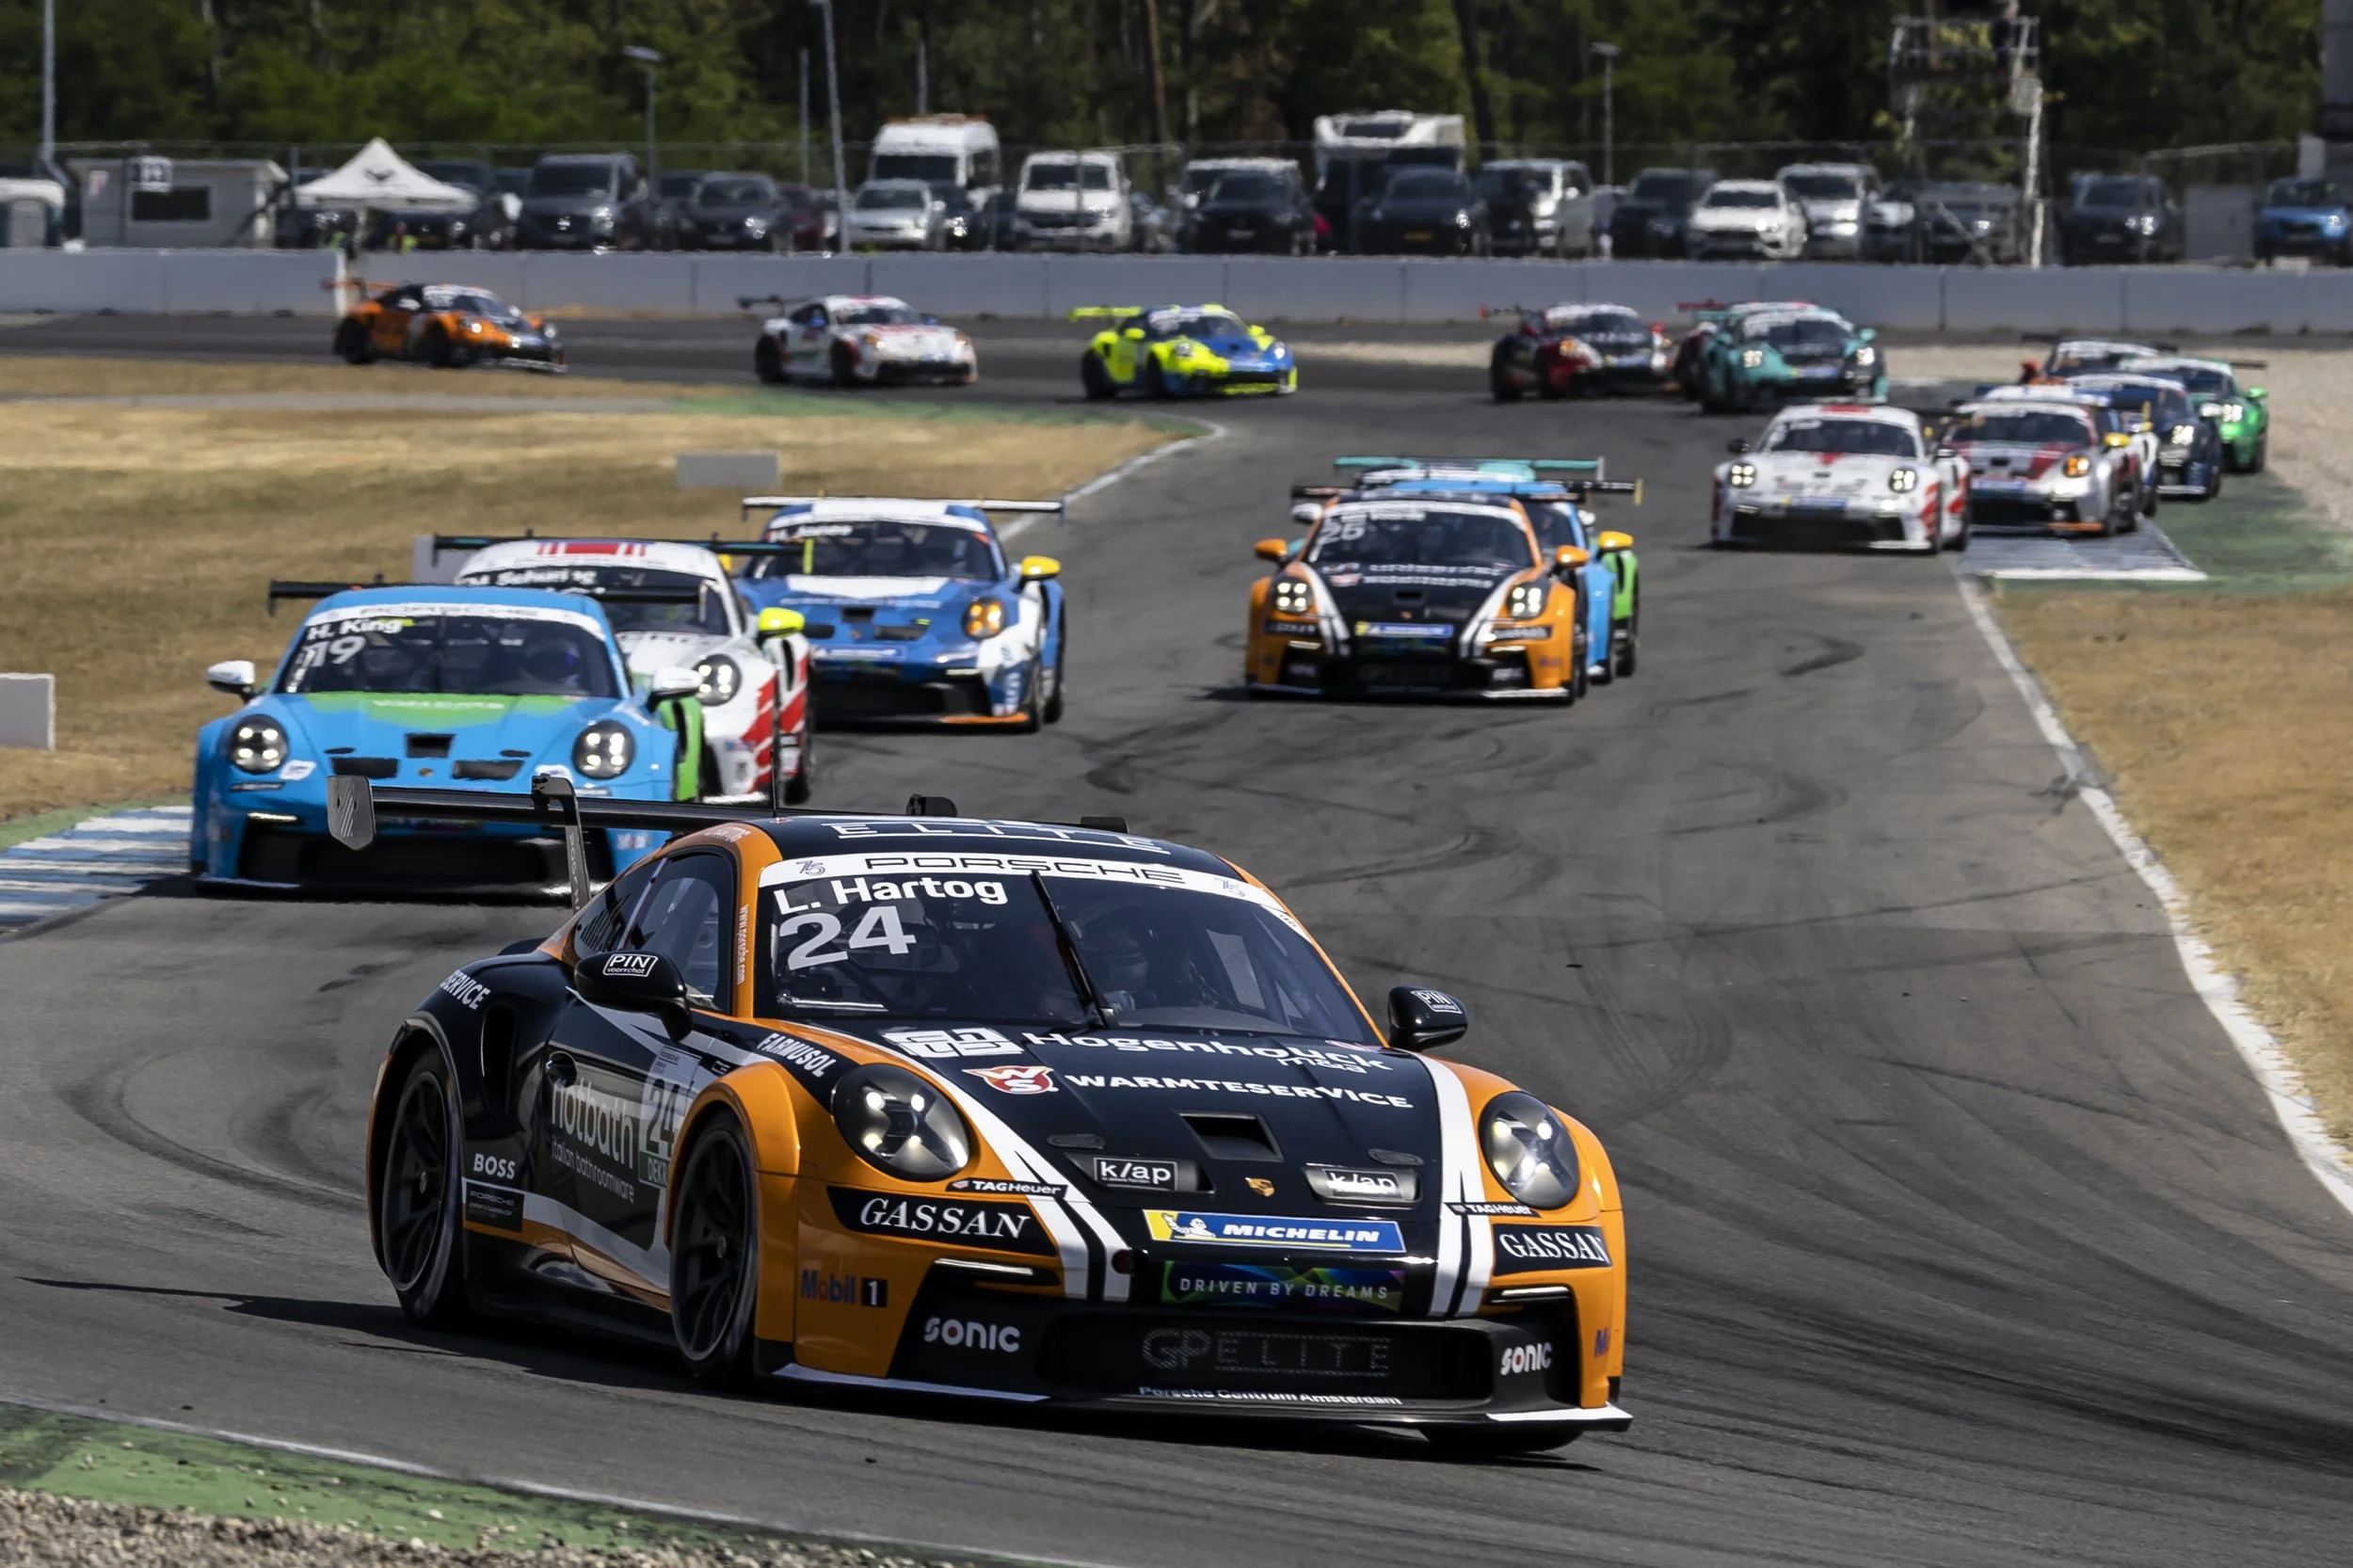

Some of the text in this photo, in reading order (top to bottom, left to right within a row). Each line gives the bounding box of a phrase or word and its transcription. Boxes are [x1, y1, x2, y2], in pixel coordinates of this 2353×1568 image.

[307, 618, 403, 641] H. King
[864, 857, 1187, 885] PORSCHE
[774, 876, 1010, 916] L. Hartog
[779, 905, 918, 971] 24
[609, 955, 650, 968] PIN
[1021, 1032, 1394, 1071] Hogenhouck
[1064, 1075, 1415, 1109] WARMTESERVICE
[473, 1153, 516, 1180] BOSS
[859, 1197, 1032, 1240] GASSAN
[1224, 1224, 1380, 1242] MICHELIN
[1499, 1232, 1610, 1265] GASSAN
[801, 1268, 857, 1304] Mobil
[1179, 1278, 1388, 1300] DRIVEN BY DREAMS
[1217, 1337, 1390, 1370] ELITE
